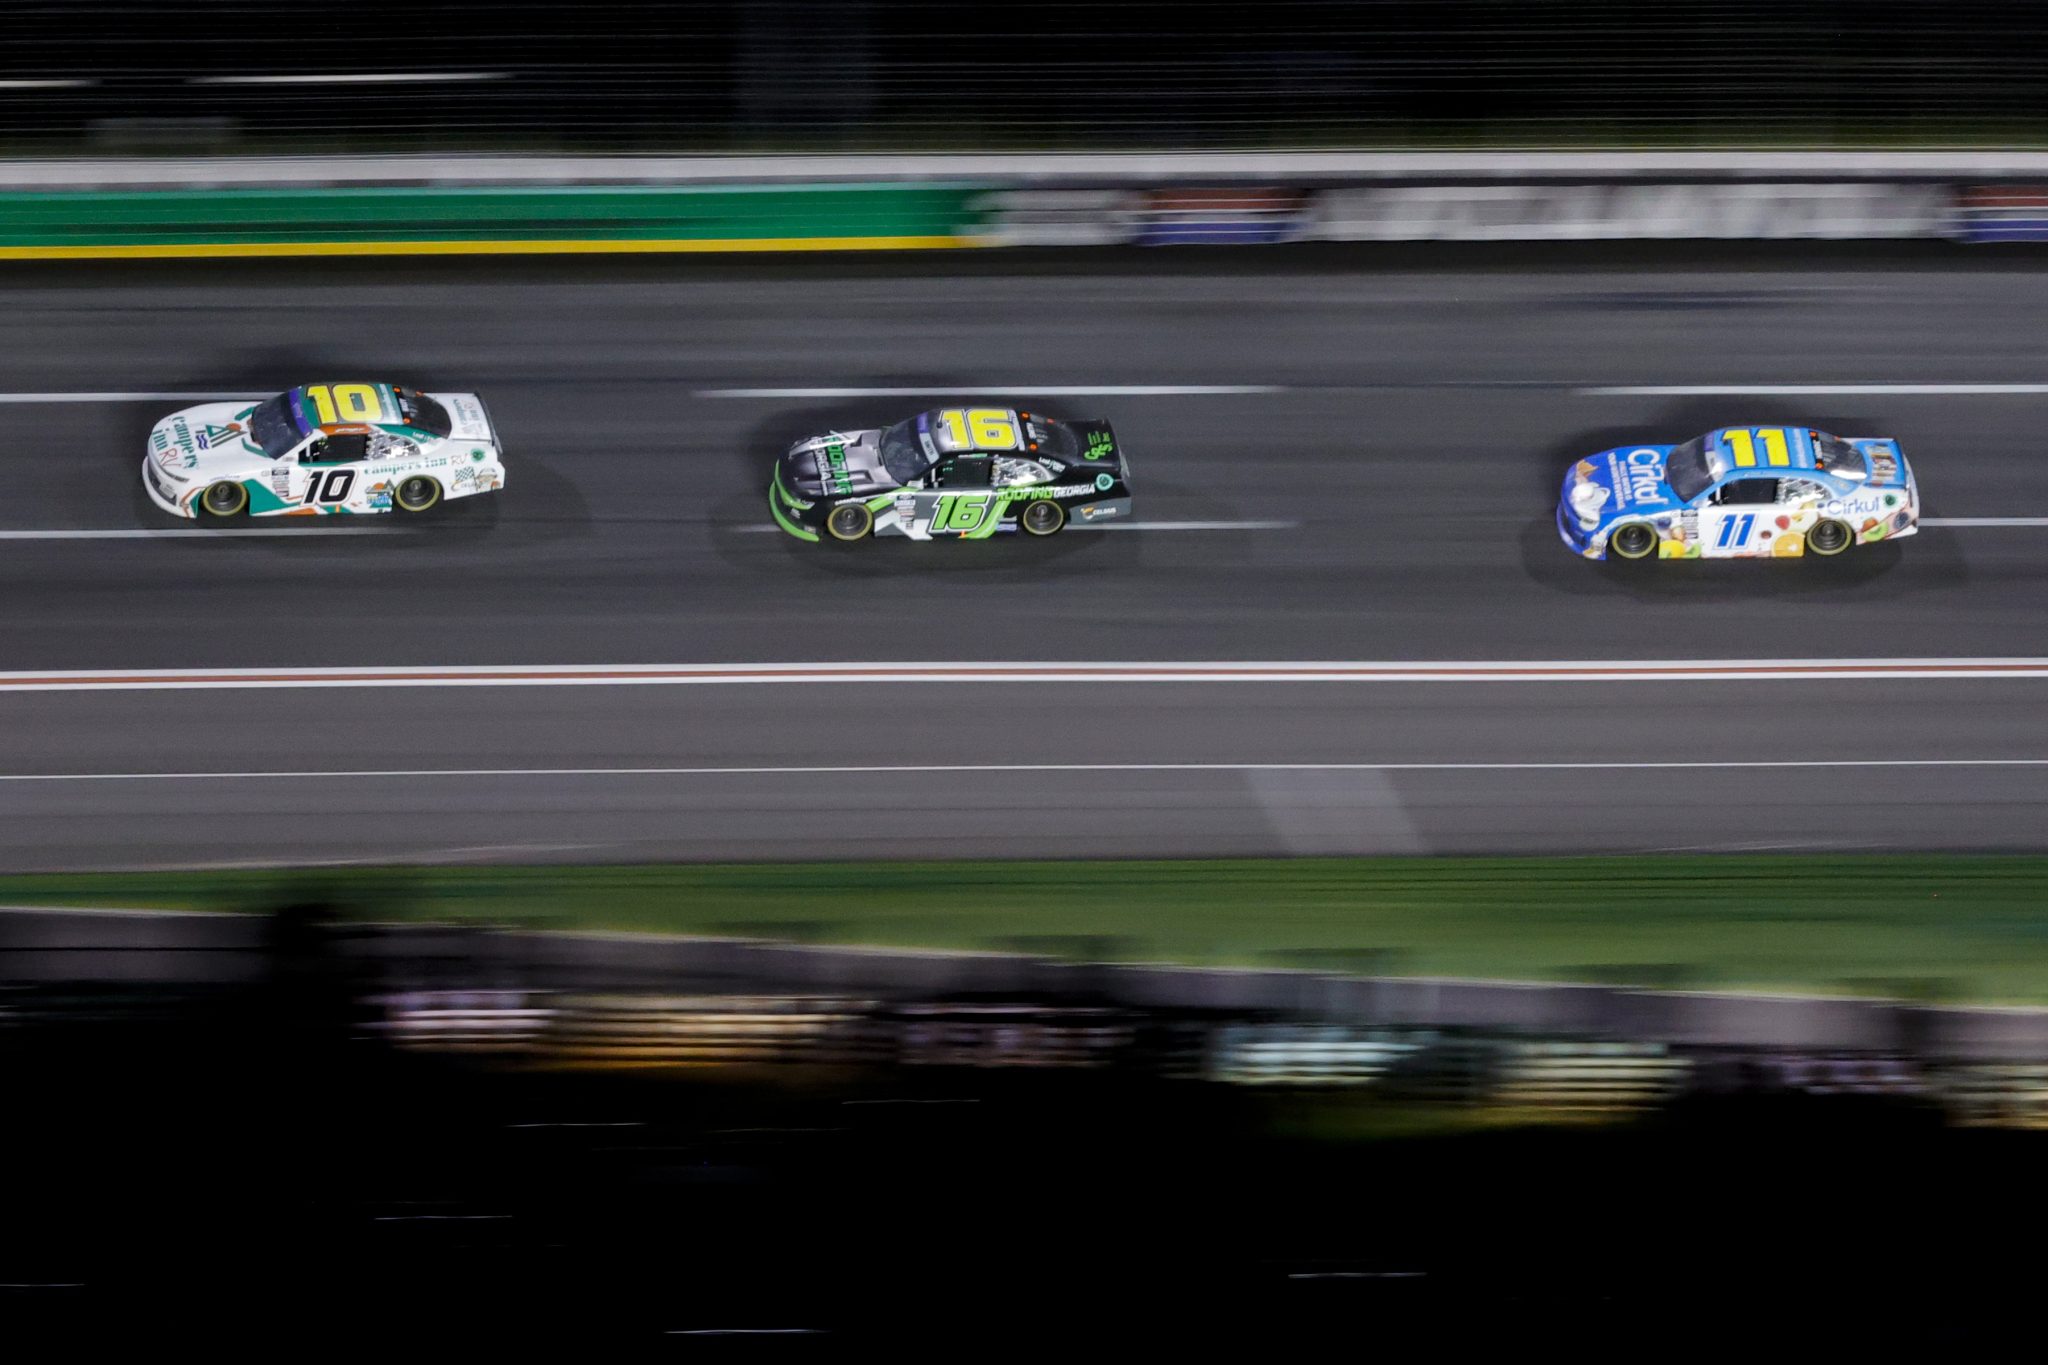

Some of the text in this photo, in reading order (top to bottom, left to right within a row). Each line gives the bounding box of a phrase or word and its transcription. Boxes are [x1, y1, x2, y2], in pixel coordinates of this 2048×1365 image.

[307, 383, 383, 424] 10
[941, 409, 1016, 449] 16
[159, 447, 182, 467] RV
[1722, 429, 1790, 467] 11
[303, 469, 355, 504] 10
[996, 484, 1095, 500] ROOFING GEORGIA
[1627, 448, 1669, 505] Cirkul
[931, 494, 988, 531] 16
[1826, 497, 1880, 515] Cirkul
[1717, 513, 1756, 547] 11
